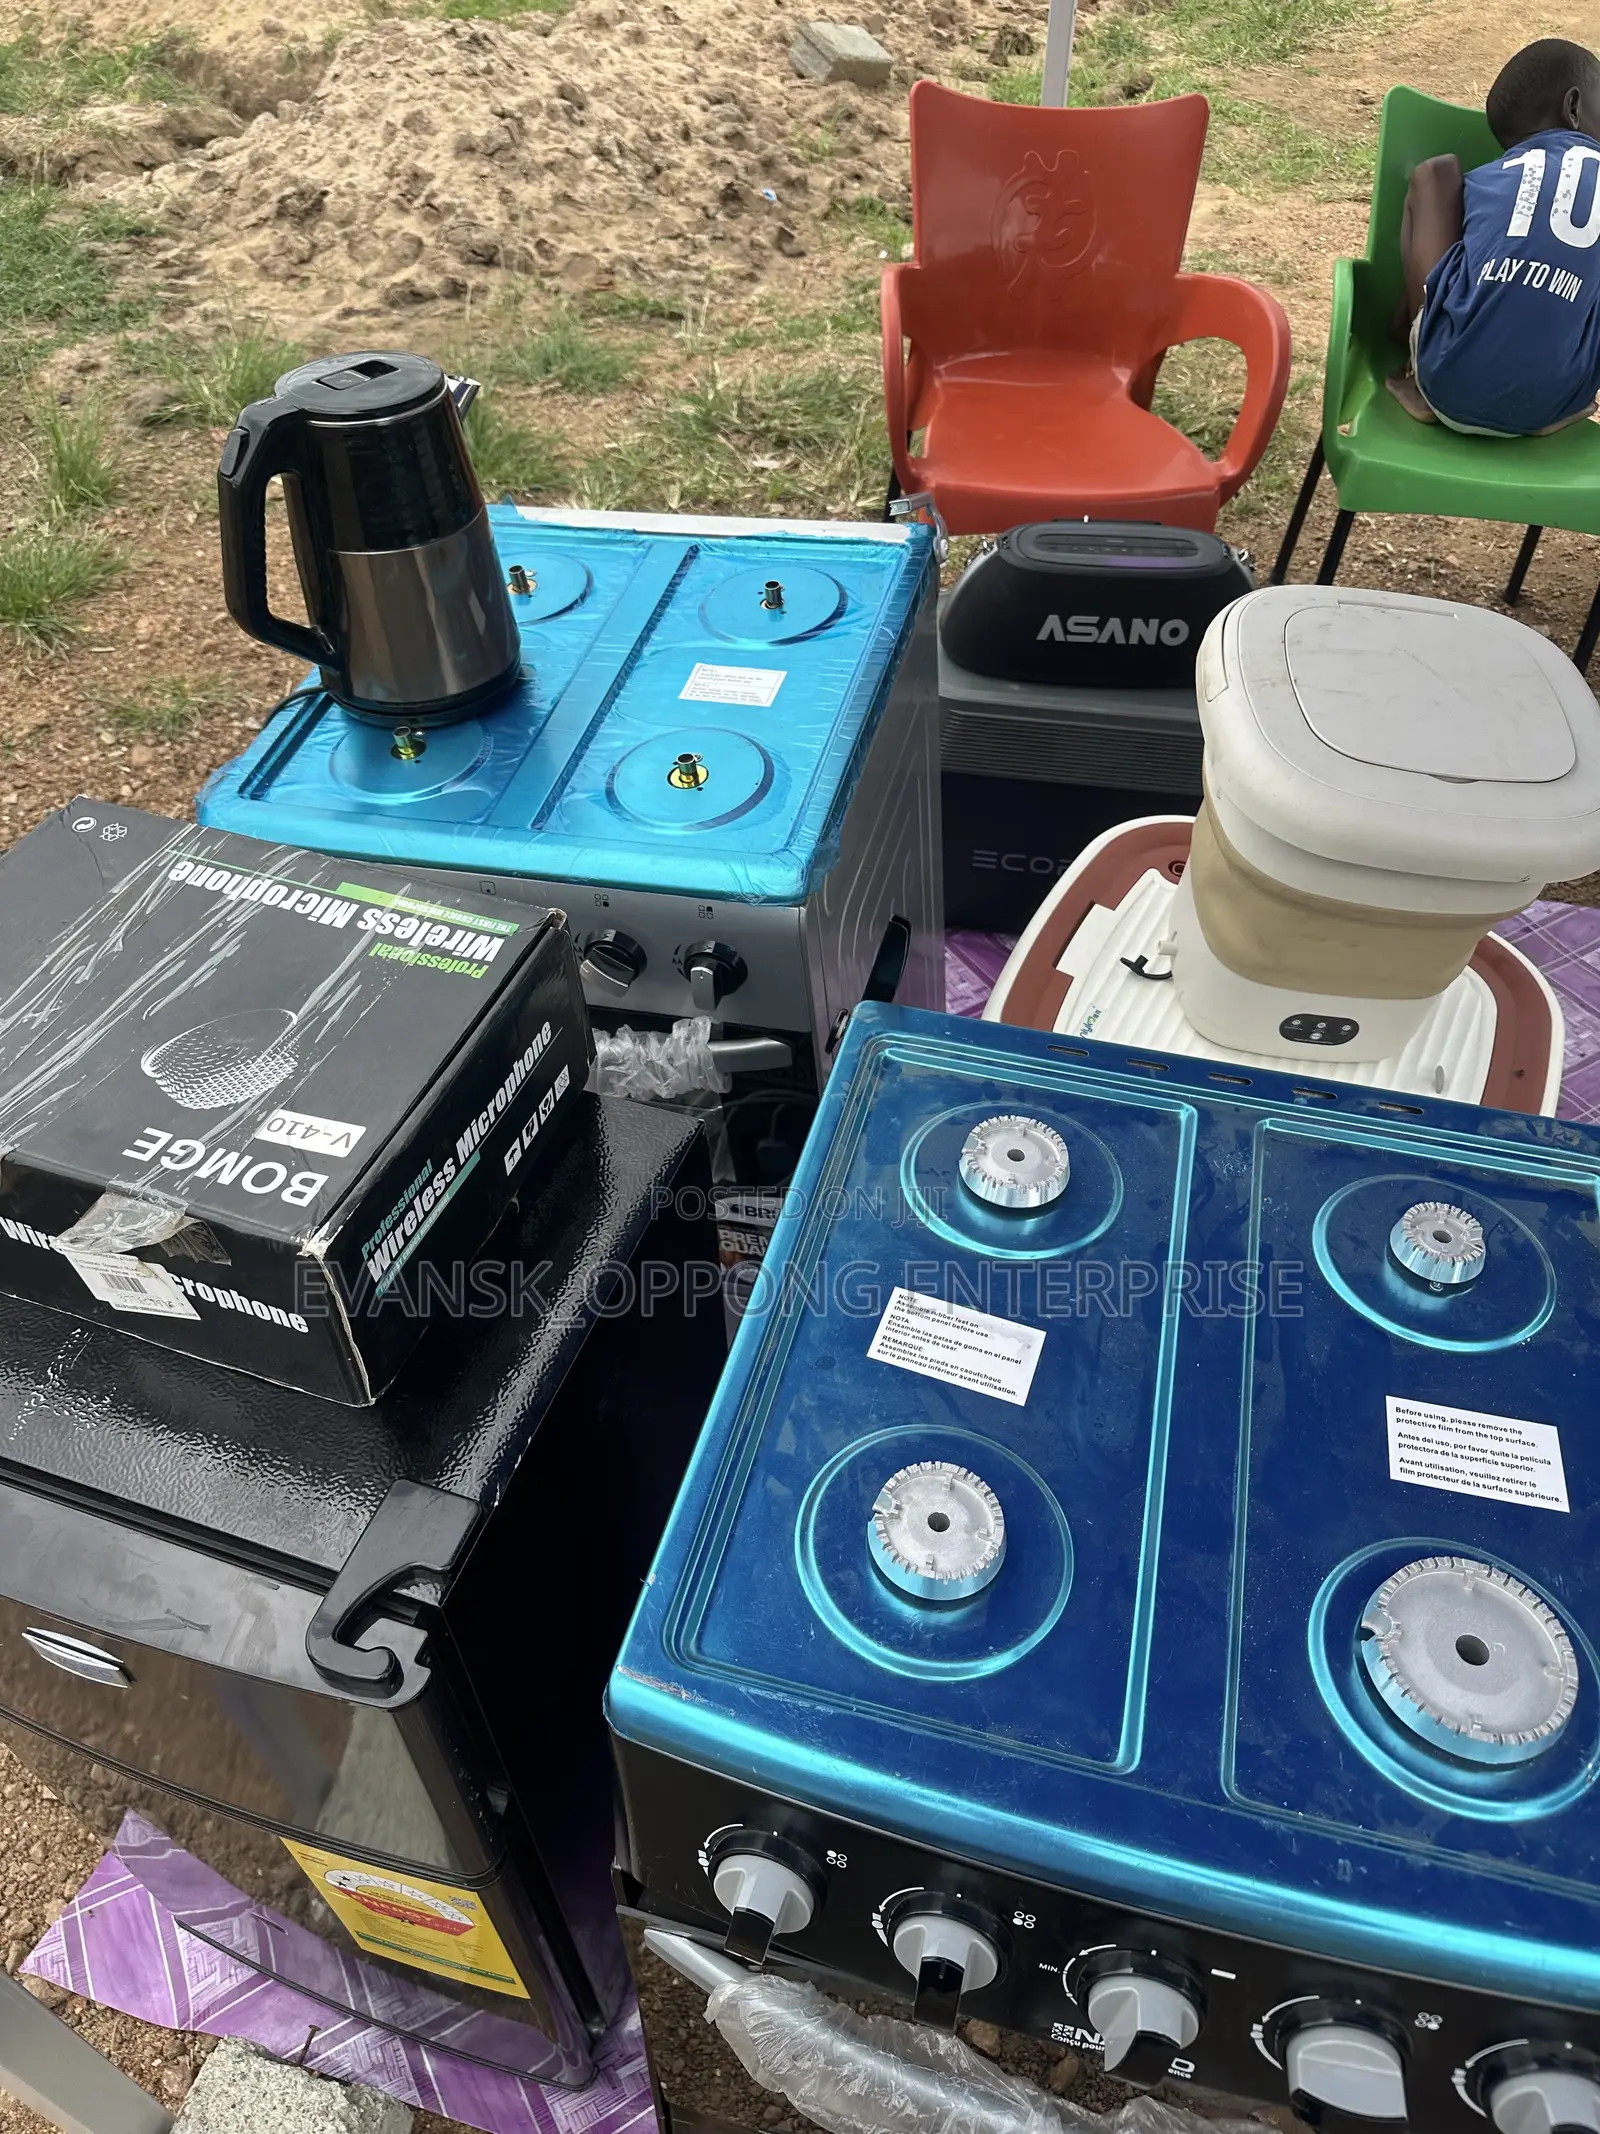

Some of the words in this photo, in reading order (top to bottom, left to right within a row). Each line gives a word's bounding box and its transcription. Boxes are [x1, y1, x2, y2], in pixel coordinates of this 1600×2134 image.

[1502, 145, 1600, 249] 10
[1476, 257, 1526, 286] PLAY
[1522, 260, 1551, 289] TO
[1547, 267, 1583, 303] WIN
[1036, 614, 1190, 647] ASANO
[167, 860, 360, 929] Microphone
[356, 907, 506, 962] Wireless
[367, 942, 490, 979] Professional
[266, 1117, 352, 1149] V-410
[121, 1127, 330, 1208] BOMGE
[366, 1157, 456, 1283] Wireless
[455, 1021, 552, 1166] Microphone
[361, 1158, 434, 1261] Professional
[720, 1240, 767, 1257] QUA
[168, 1272, 309, 1334] crophone
[896, 1300, 930, 1313] Assemble
[931, 1310, 954, 1320] rubber
[955, 1317, 969, 1326] feet
[907, 1308, 931, 1320] bottom
[931, 1317, 951, 1326] panel
[952, 1322, 974, 1334] before
[885, 1326, 910, 1337] interior
[912, 1335, 930, 1344] antes
[888, 1320, 921, 1334] Ensamble
[922, 1330, 932, 1338] las
[933, 1334, 952, 1344] patas
[964, 1344, 983, 1354] goma
[1001, 1355, 1022, 1365] panel
[876, 1348, 888, 1356] sur
[896, 1355, 927, 1368] panneau
[928, 1364, 958, 1377] inférieur
[958, 1374, 979, 1384] avant
[980, 1380, 1018, 1397] utilisation.
[879, 1342, 917, 1358] Assemblez
[929, 1358, 948, 1368] pieds
[960, 1366, 1002, 1384] caoutchouc
[1396, 1406, 1422, 1417] Before
[1424, 1413, 1448, 1423] using,
[1450, 1418, 1476, 1427] please
[1478, 1423, 1508, 1432] remove
[1510, 1428, 1522, 1436] the
[1396, 1417, 1437, 1430] protective
[1438, 1424, 1454, 1432] film
[1454, 1427, 1474, 1436] from
[1490, 1434, 1504, 1442] top
[1505, 1438, 1538, 1448] surface.
[1397, 1432, 1420, 1442] Antes
[1422, 1436, 1434, 1444] del
[1435, 1440, 1452, 1448] uso,
[1468, 1445, 1488, 1454] favor
[1490, 1450, 1510, 1458] quite
[1398, 1442, 1438, 1455] protectora
[1460, 1454, 1499, 1466] superficie
[1500, 1461, 1536, 1473] superior.
[1399, 1456, 1424, 1467] Avant
[1424, 1462, 1468, 1476] utilisation,
[1469, 1470, 1500, 1482] veuillez
[1502, 1478, 1528, 1486] retirer
[1400, 1467, 1416, 1476] film
[1416, 1471, 1460, 1484] protecteur
[1482, 1484, 1513, 1494] surface
[1514, 1490, 1562, 1503] supérieure.
[1038, 1962, 1061, 1974] MIN.
[1051, 2033, 1080, 2047] Conçu
[1168, 2067, 1192, 2079] ence
